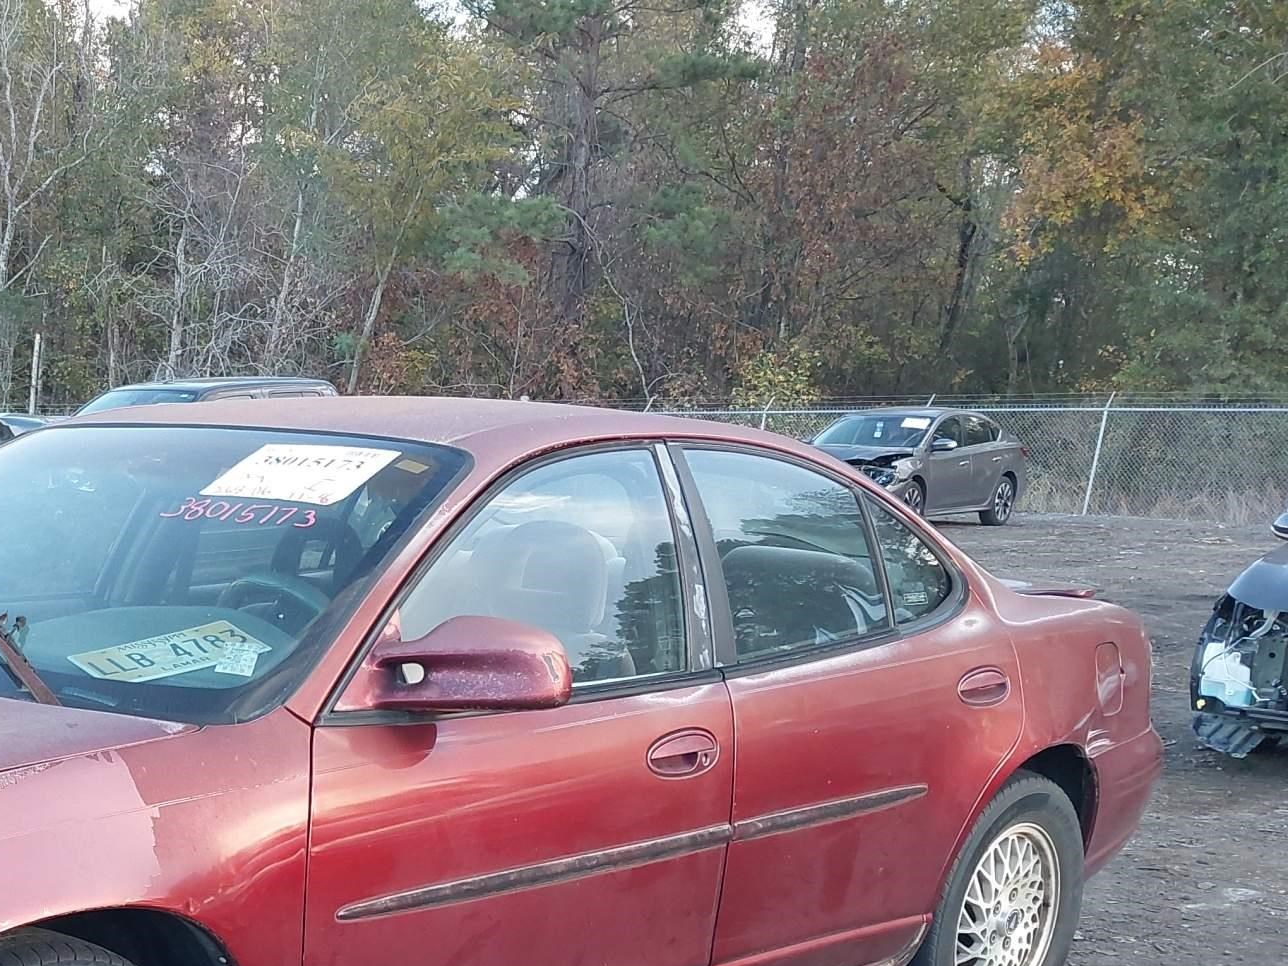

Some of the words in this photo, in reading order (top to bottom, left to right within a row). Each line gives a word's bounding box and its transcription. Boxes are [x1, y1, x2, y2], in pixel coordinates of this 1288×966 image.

[160, 496, 317, 528] 38015173
[88, 652, 155, 677] LLB
[170, 629, 247, 659] 4783
[160, 655, 211, 671] LAMAR
